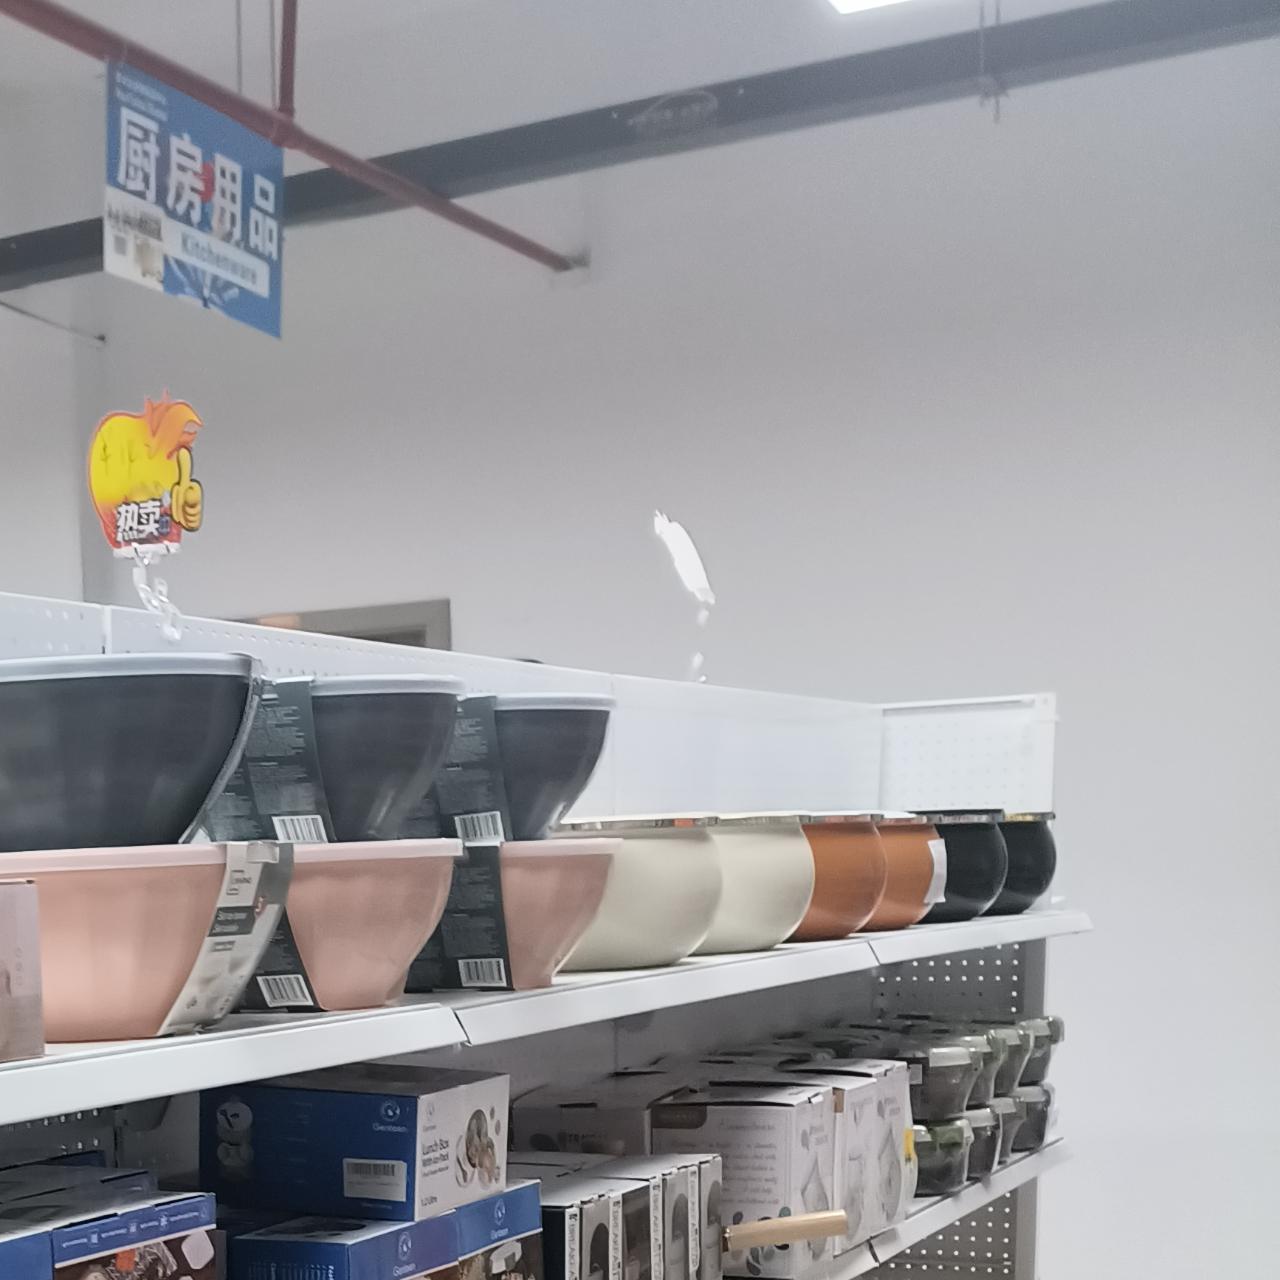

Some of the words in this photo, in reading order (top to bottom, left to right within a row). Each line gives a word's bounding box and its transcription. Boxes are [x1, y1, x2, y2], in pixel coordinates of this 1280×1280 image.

[117, 105, 278, 261] 厨房用品
[116, 500, 161, 542] 热卖
